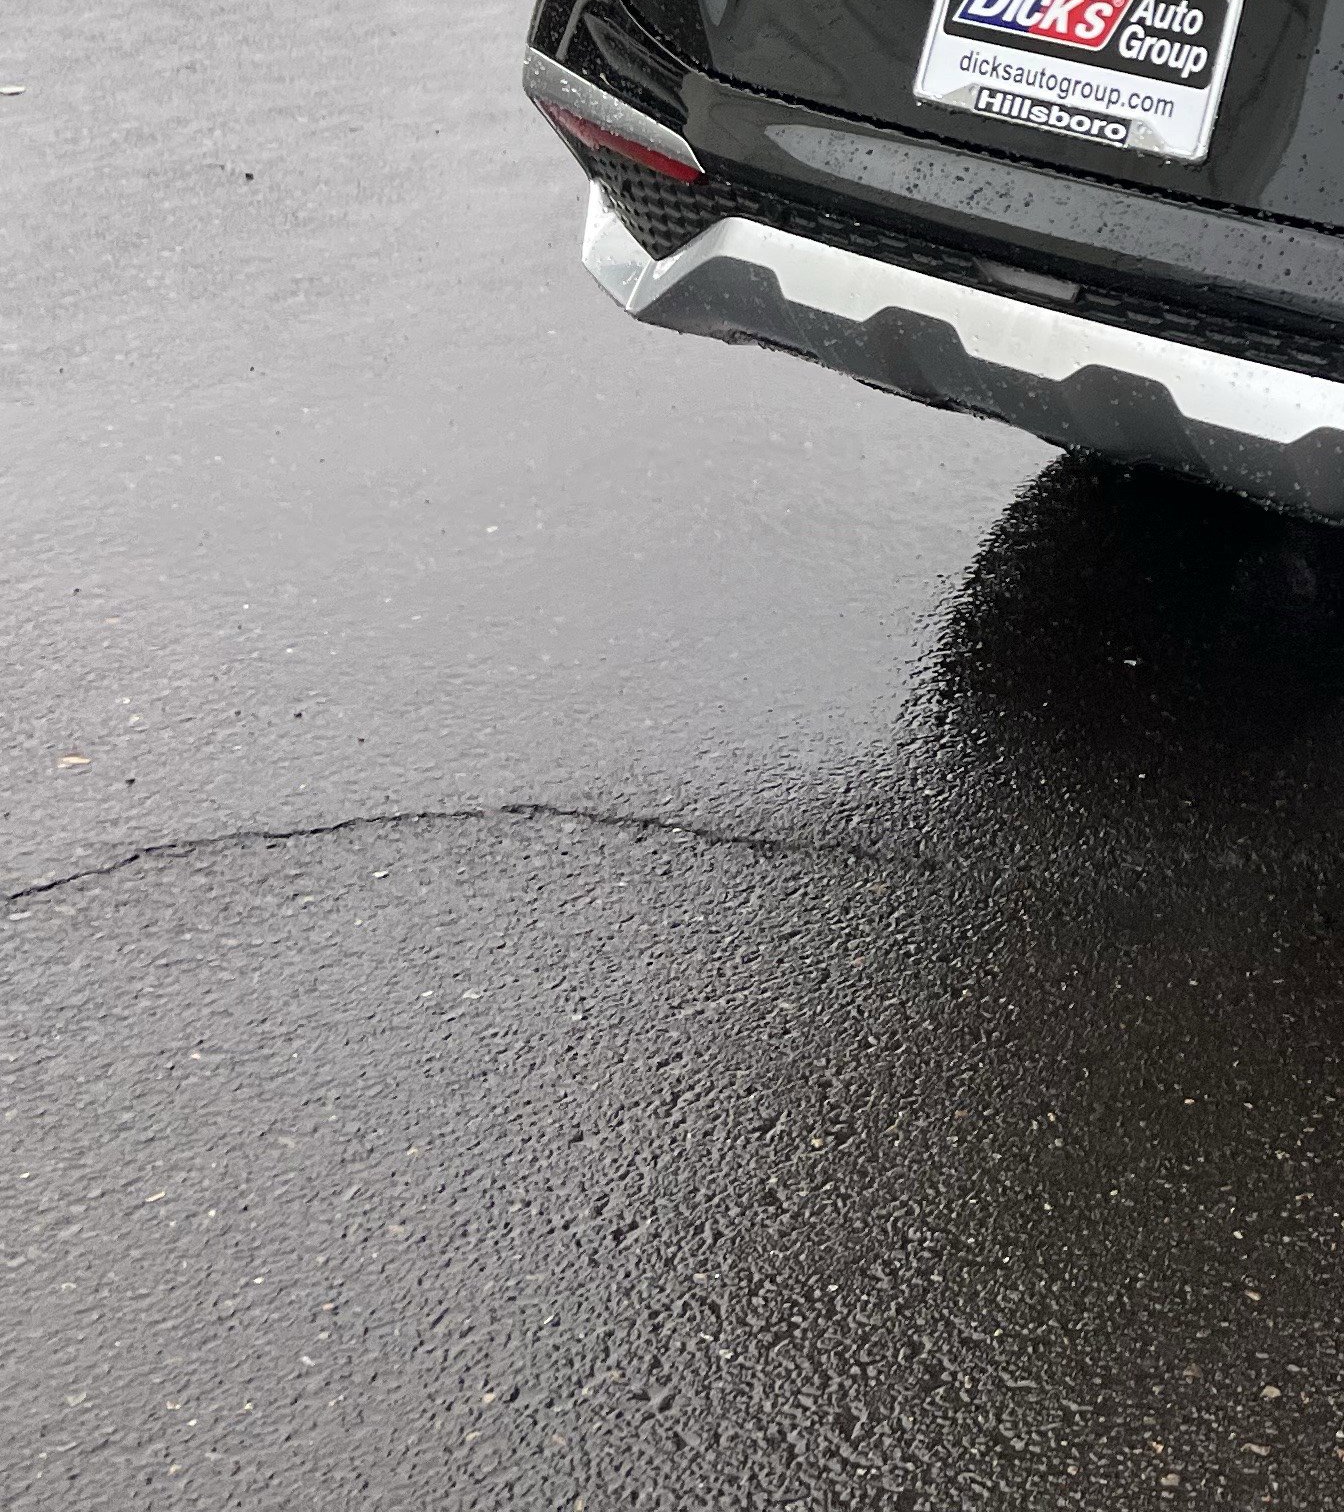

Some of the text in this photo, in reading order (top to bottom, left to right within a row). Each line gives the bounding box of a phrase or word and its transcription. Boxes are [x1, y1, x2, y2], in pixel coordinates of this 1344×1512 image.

[1117, 23, 1209, 79] Group
[959, 51, 1175, 119] dicksautogroup.com
[975, 88, 1128, 142] Hillsboro
